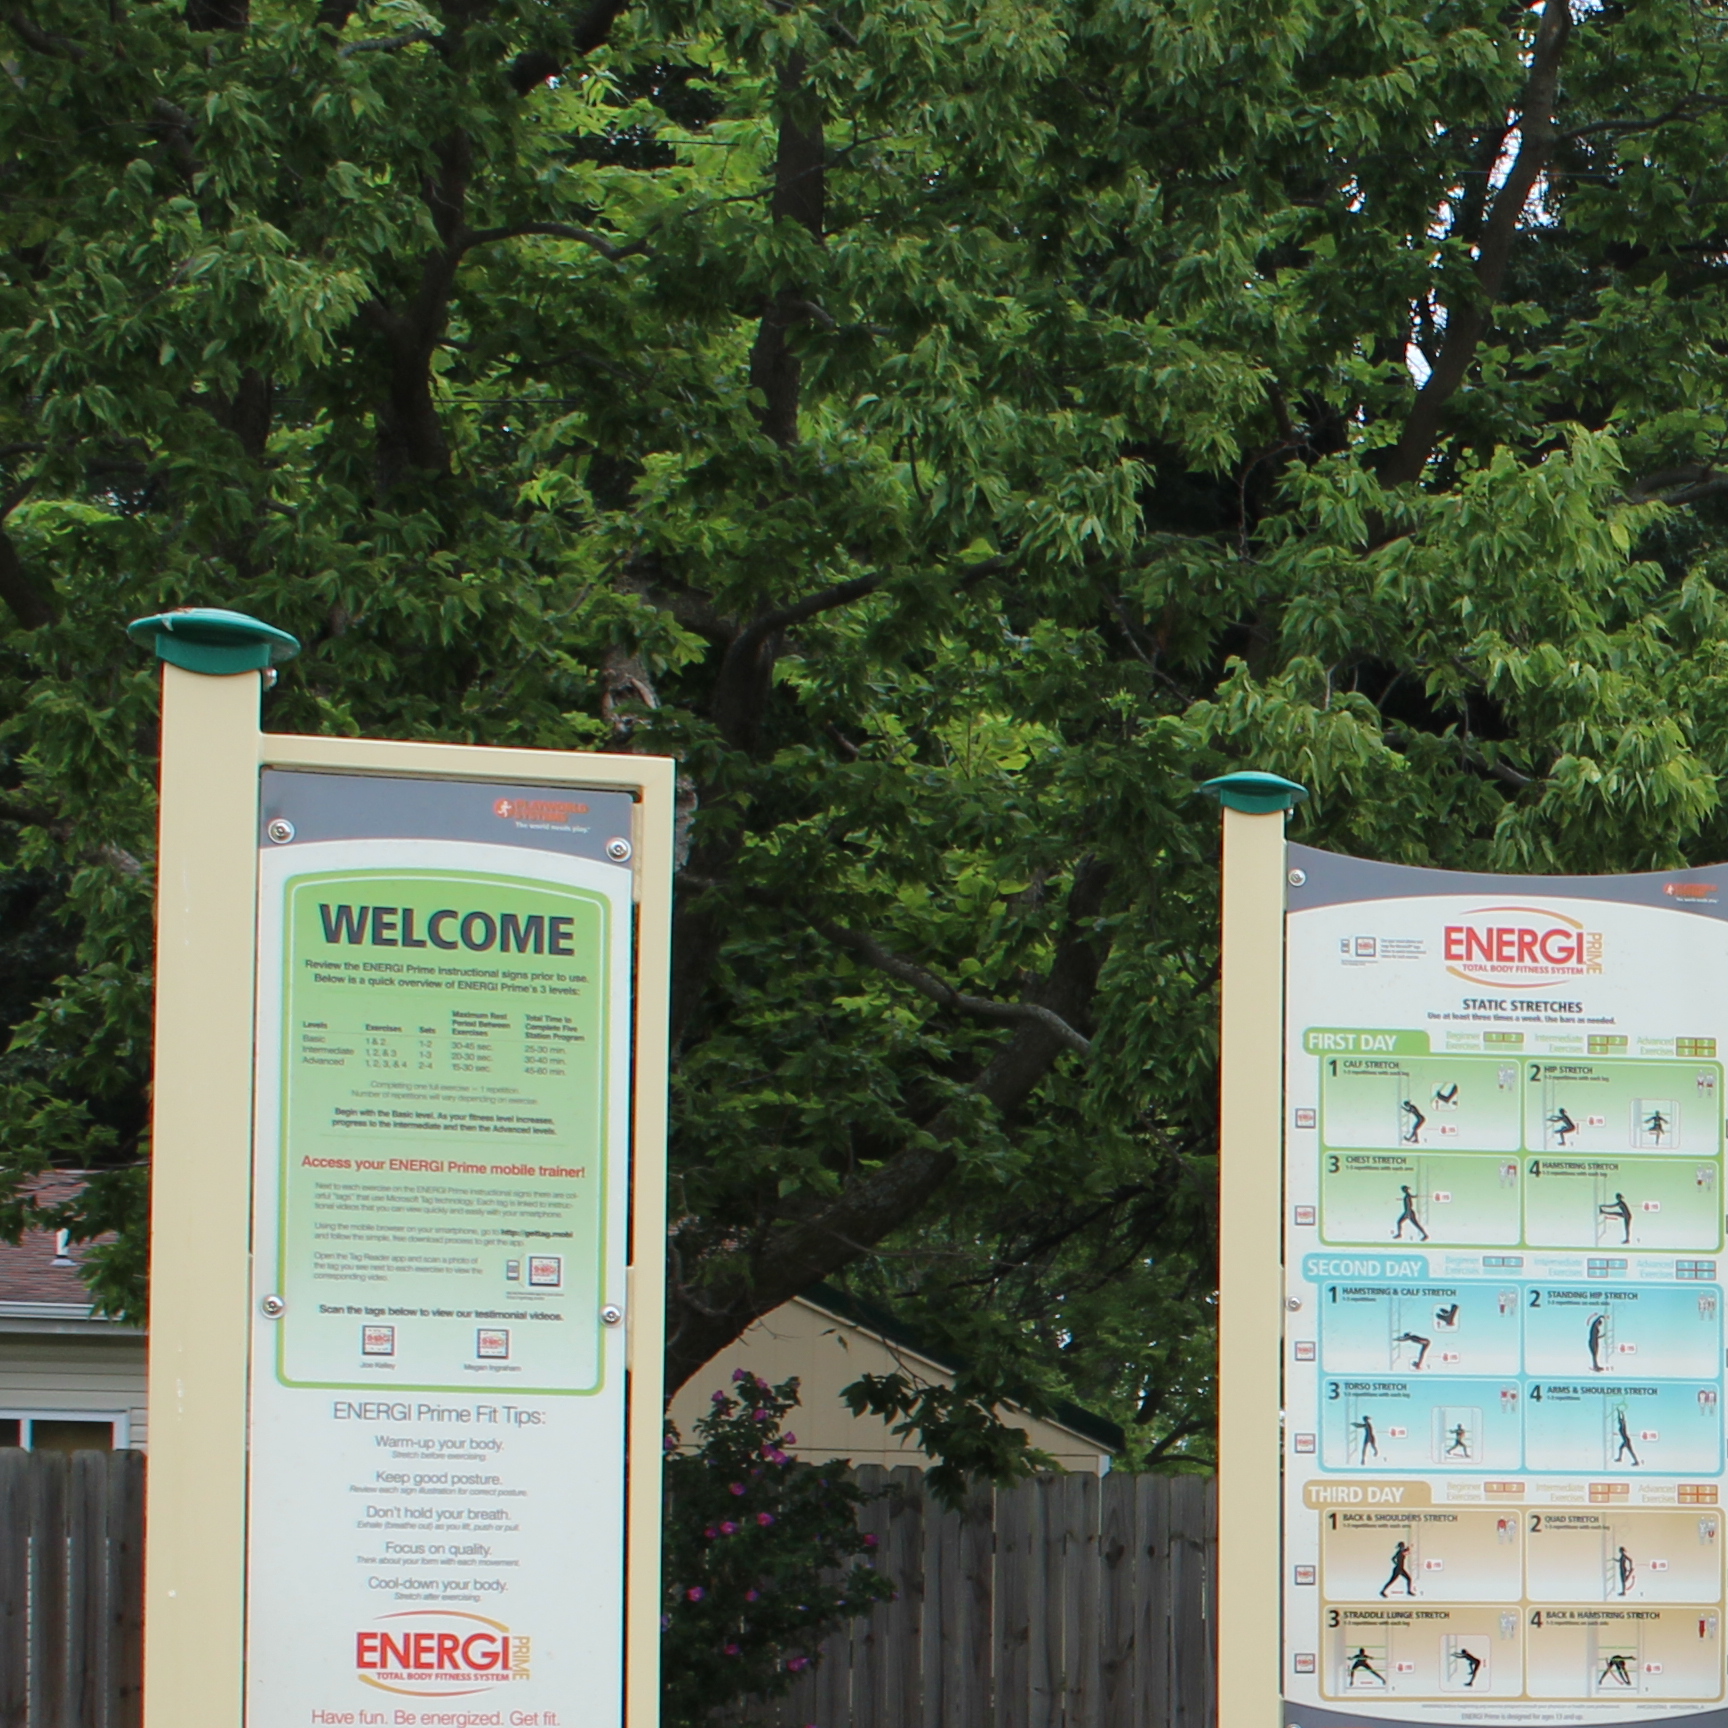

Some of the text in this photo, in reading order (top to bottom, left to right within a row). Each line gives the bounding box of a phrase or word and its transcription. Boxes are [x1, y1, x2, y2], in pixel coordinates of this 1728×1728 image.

[319, 903, 576, 956] WELCOME
[1444, 925, 1584, 965] ENERGI
[1586, 932, 1603, 975] PRIME
[305, 959, 590, 983] Review the ENERGI Prime instructional signs prior to use.
[1462, 963, 1584, 975] TOTAL BODY FITNESS SYSTEM
[1463, 998, 1583, 1013] STATIC STRETCHES
[1308, 1033, 1397, 1051] FIRST DAY
[1328, 1059, 1399, 1077] 1 CALF STRETCH
[1529, 1064, 1593, 1082] 2 HIP STRETCH
[301, 1155, 586, 1179] Access your ENERGI Prime mobile trainer!
[1328, 1155, 1407, 1173] 3 CHEST STRETCH
[1529, 1160, 1619, 1178] 4 HAMSTRING STRETCH
[1307, 1258, 1422, 1277] SECOND DAY
[1328, 1286, 1457, 1304] 1 HAMSTRING & CALF STRETCH
[1529, 1290, 1638, 1308] 2 STANDING HIP STRETCH
[319, 1304, 345, 1315] Scan
[347, 1305, 363, 1315] the
[364, 1306, 386, 1317] tags
[388, 1307, 418, 1317] below
[420, 1308, 429, 1317] to
[432, 1308, 454, 1318] view
[474, 1309, 527, 1320] testimonial
[530, 1311, 564, 1321] videos.
[1328, 1382, 1407, 1400] 3 TORSO STRETCH
[1529, 1384, 1541, 1402] 4
[1547, 1386, 1570, 1394] ARMS
[1580, 1386, 1622, 1395] SHOULDER
[1624, 1387, 1658, 1395] STRETCH
[333, 1401, 547, 1427] ENERGI Prime Fit Tips:
[374, 1435, 505, 1452] Warm-up your body.
[376, 1471, 503, 1486] Keep good posture.
[1308, 1486, 1404, 1503] THIRD DAY
[366, 1505, 511, 1521] Don't hold your breath.
[1328, 1512, 1337, 1530] 1
[1343, 1514, 1365, 1522] BACK
[1375, 1514, 1421, 1522] SHOULDERS
[1423, 1514, 1457, 1522] STRETCH
[1530, 1515, 1541, 1532] 2
[1545, 1515, 1566, 1523] QUAD
[385, 1541, 492, 1557] Focus on quality.
[368, 1576, 508, 1593] Cool-down your body.
[1328, 1609, 1450, 1628] 3 STRADDLE LUNGE STRETCH
[1530, 1611, 1660, 1628] 4 BACK & HAMSTRING STRETCH
[356, 1631, 510, 1671] ENERGI
[512, 1636, 531, 1680] PRIME
[376, 1672, 510, 1682] TOTAL BODY FITNESS SYSTEM
[311, 1709, 561, 1728] Have fun. Be energized. Get fit.
